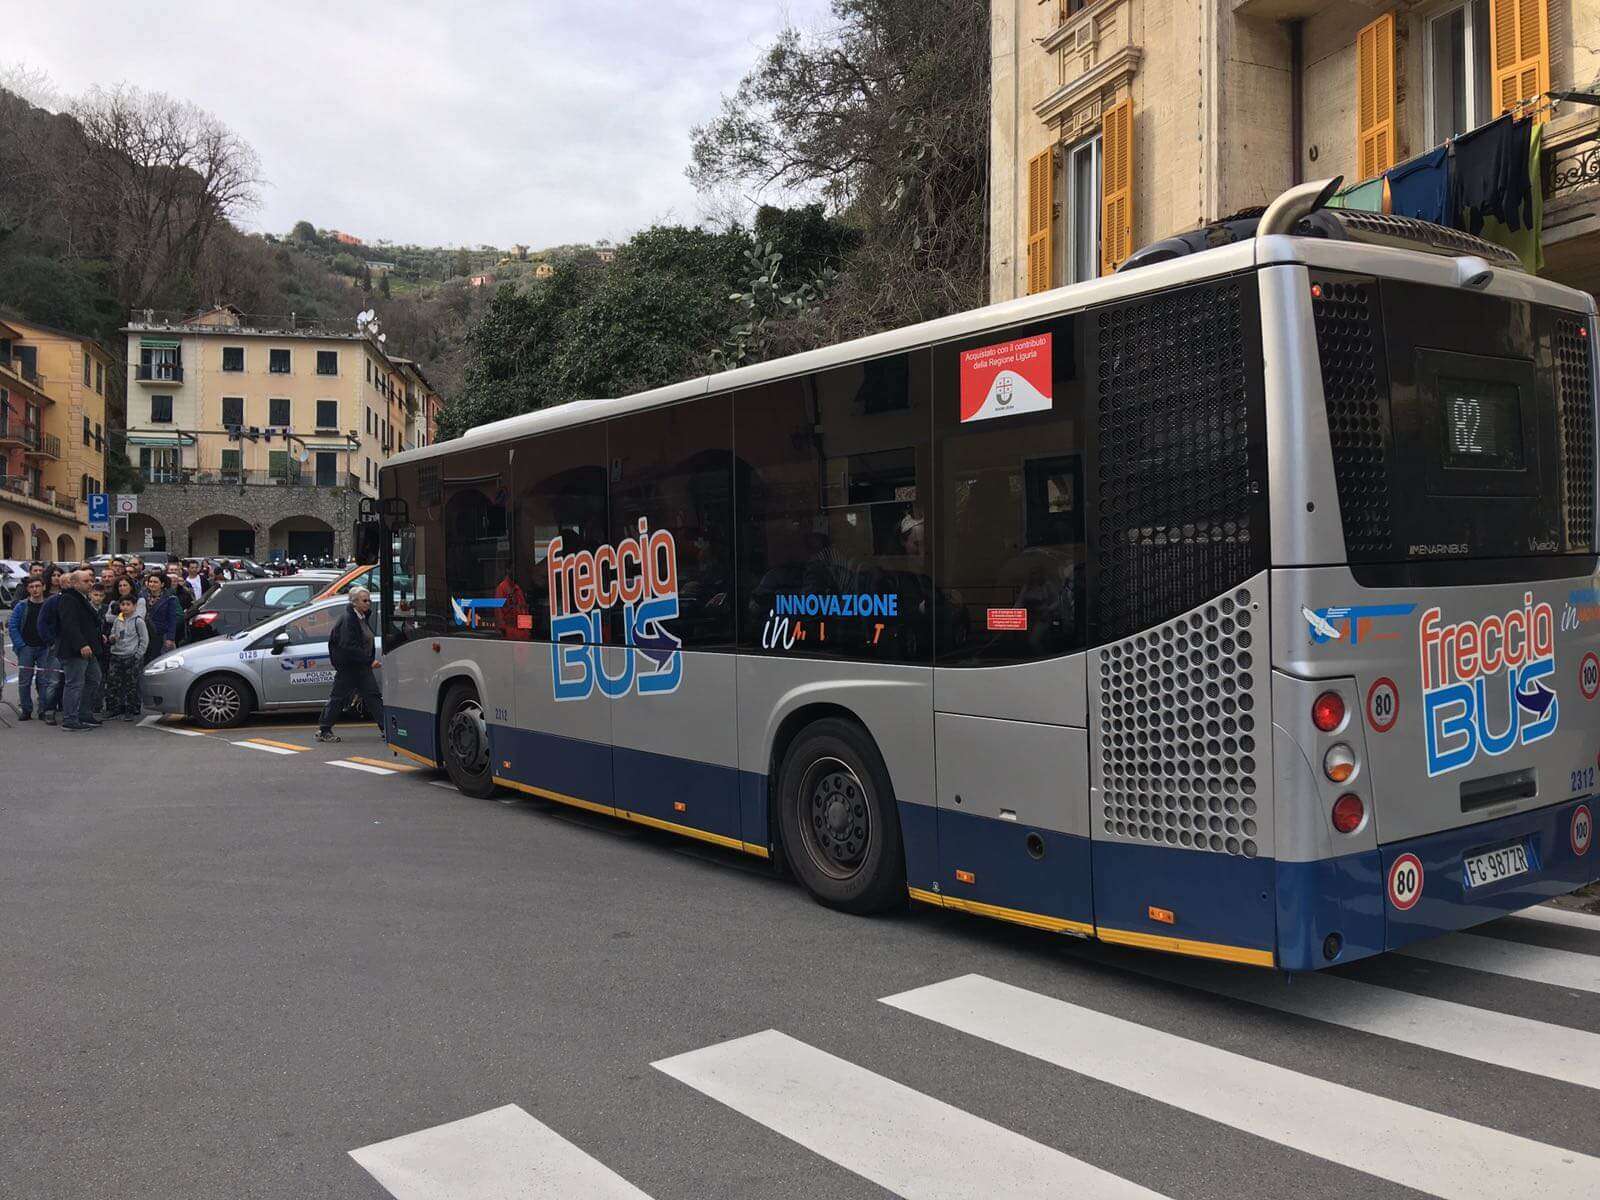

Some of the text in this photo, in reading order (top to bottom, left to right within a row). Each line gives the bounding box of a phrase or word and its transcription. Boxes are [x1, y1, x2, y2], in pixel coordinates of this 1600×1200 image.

[965, 347, 996, 363] Acquistato
[997, 346, 1009, 355] con
[1014, 337, 1047, 350] contributo
[973, 350, 1038, 369] della Regione Liguria
[1453, 397, 1482, 453] 82
[92, 495, 104, 510] P
[547, 516, 679, 618] freccia
[776, 593, 898, 616] INNOVAZIONE
[761, 608, 795, 650] in
[1419, 591, 1555, 690] freccia
[551, 596, 683, 702] BUS
[291, 675, 336, 684] AMMINISTRA
[305, 670, 333, 678] POLIZIA
[1584, 665, 1597, 687] 100
[1375, 693, 1392, 717] 80
[1424, 657, 1559, 778] BUS
[1571, 767, 1595, 792] 2312
[1575, 821, 1589, 841] 100
[1467, 847, 1528, 885] FG 987ZR
[1396, 868, 1416, 896] 80
